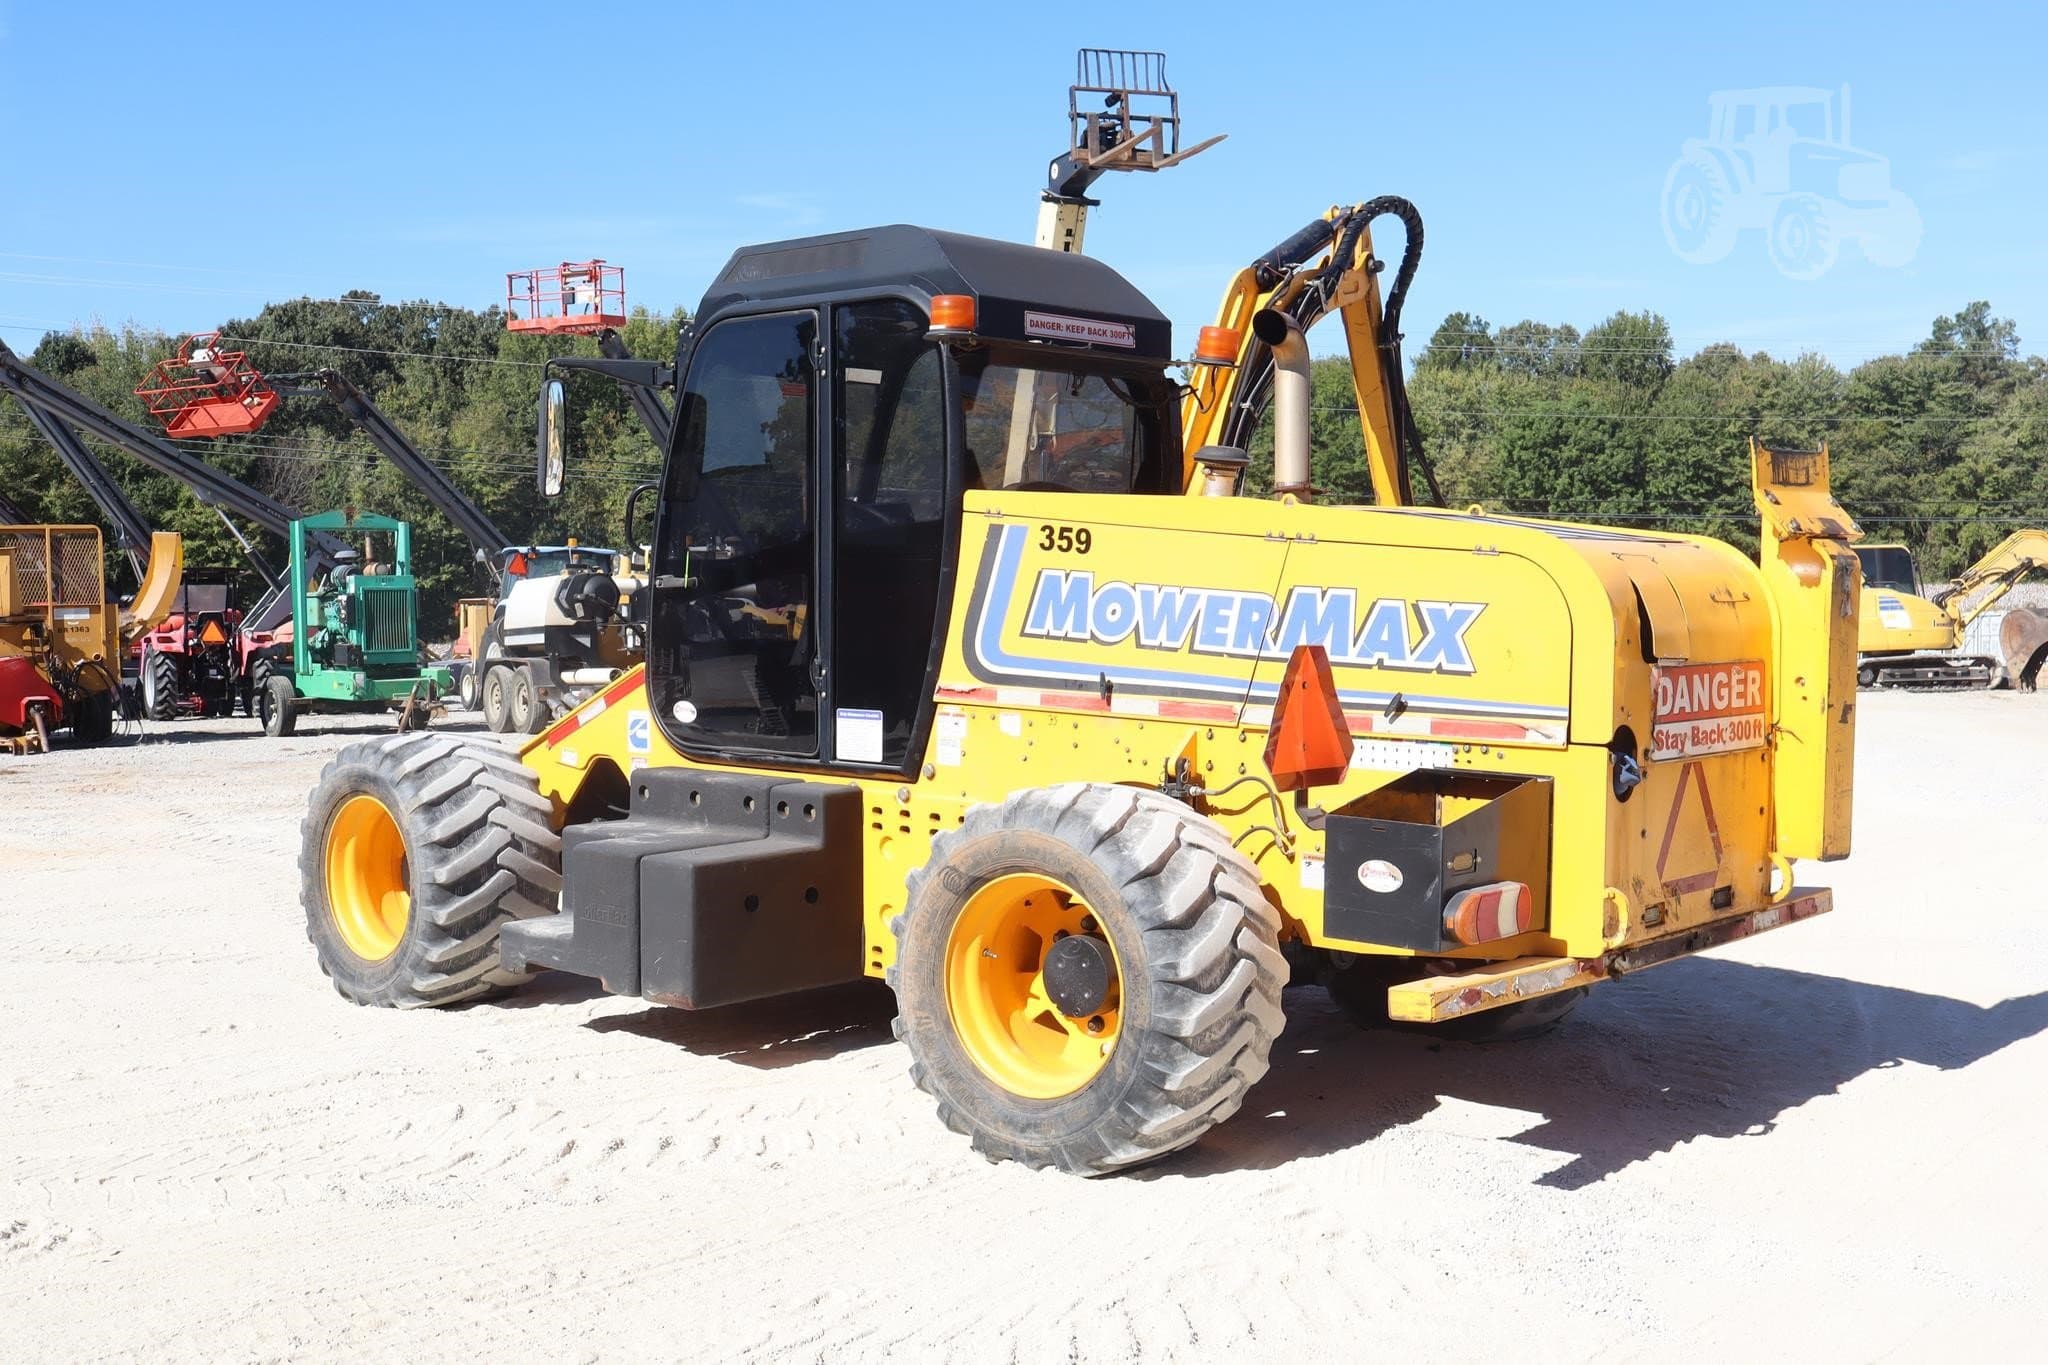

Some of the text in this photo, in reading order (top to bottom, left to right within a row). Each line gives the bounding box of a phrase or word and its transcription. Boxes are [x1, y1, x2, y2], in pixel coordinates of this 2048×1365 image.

[1029, 319, 1063, 332] DANGER:
[1065, 324, 1086, 334] KEEP
[1087, 326, 1108, 338] BACK
[1039, 524, 1092, 554] 359
[1656, 669, 1762, 716] DANGER
[1655, 719, 1762, 753] Stay Back 300 ft
